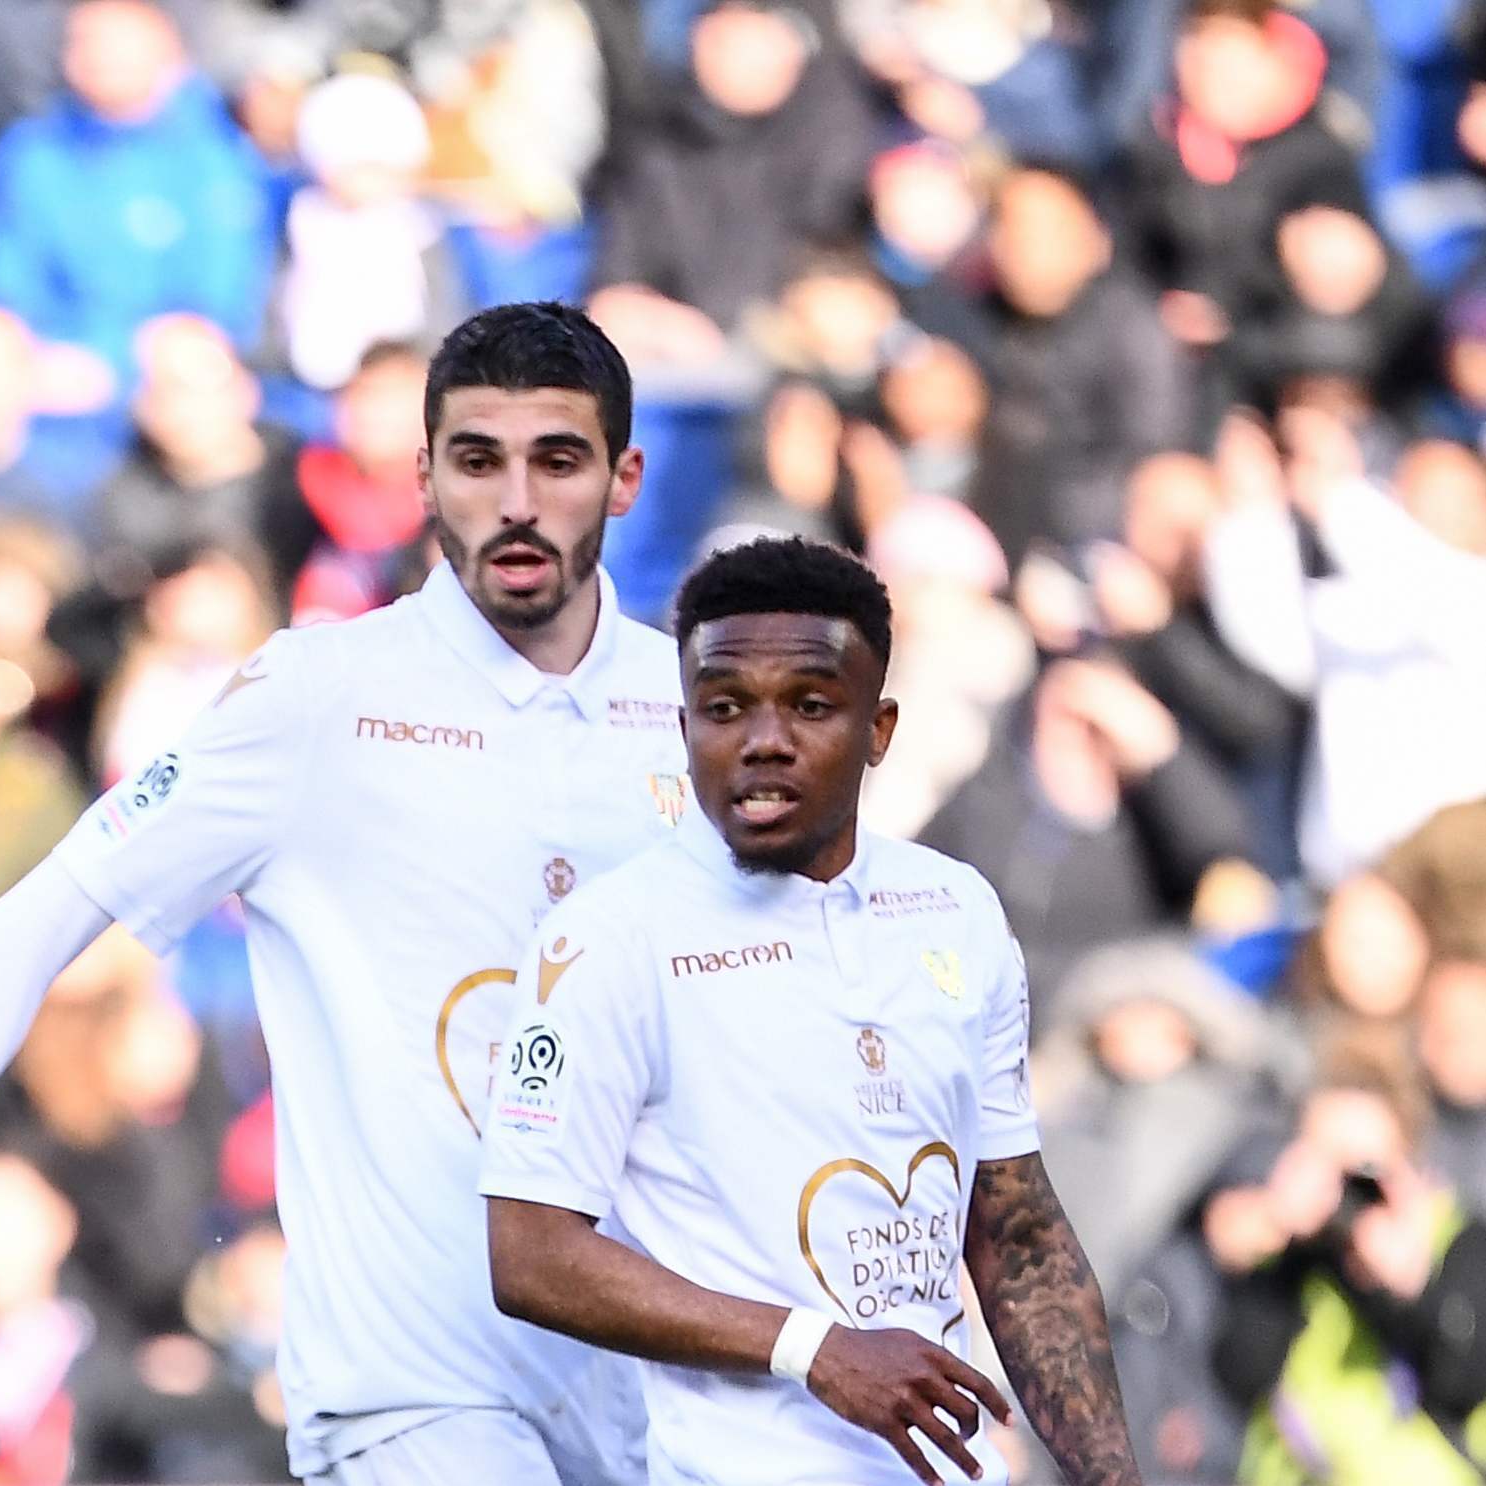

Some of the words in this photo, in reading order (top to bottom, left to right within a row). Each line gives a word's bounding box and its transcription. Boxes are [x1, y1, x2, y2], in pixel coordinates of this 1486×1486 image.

[357, 717, 484, 750] macron
[671, 941, 793, 978] macron
[847, 1217, 923, 1254] FONDS
